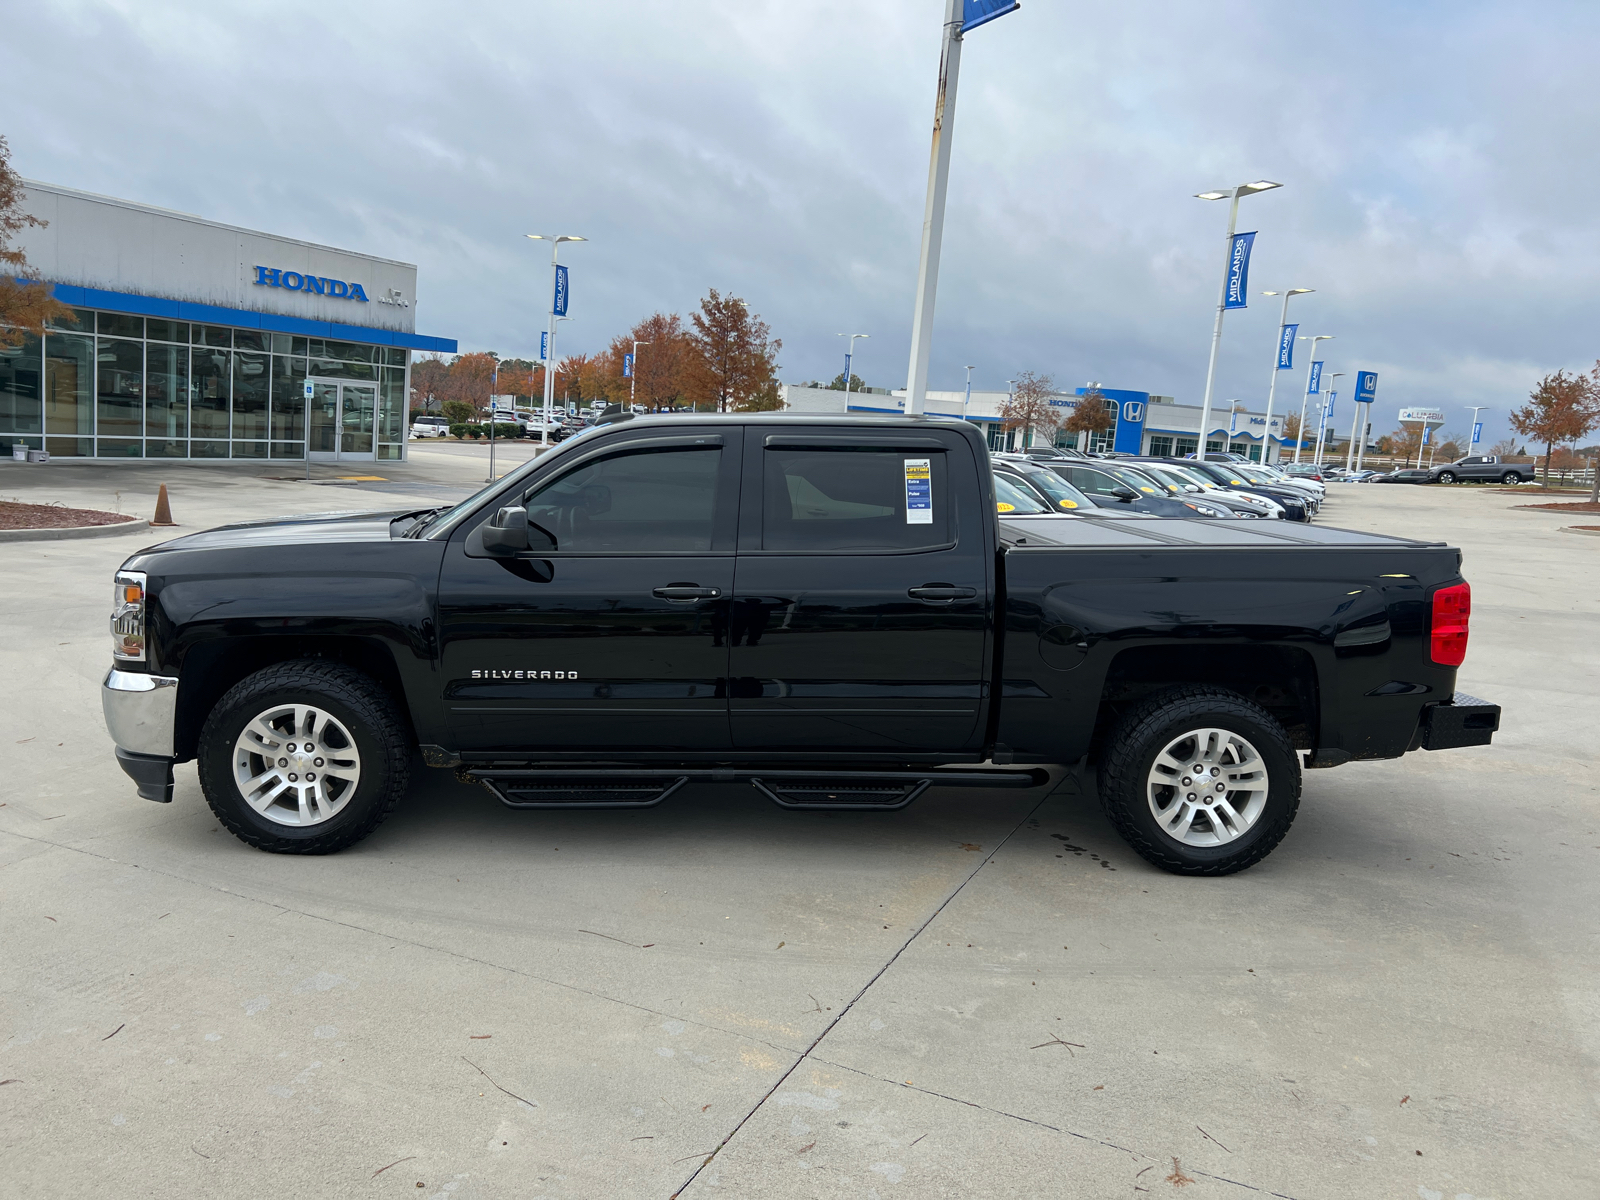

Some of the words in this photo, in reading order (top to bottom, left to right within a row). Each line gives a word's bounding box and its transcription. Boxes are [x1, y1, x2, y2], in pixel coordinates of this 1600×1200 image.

[1229, 238, 1244, 302] MIDLANDS
[253, 265, 369, 302] HONDA
[1281, 328, 1292, 365] MIDLANDS
[1049, 399, 1080, 408] HOND
[1249, 417, 1279, 426] Midlds
[471, 670, 578, 680] SILVERADO
